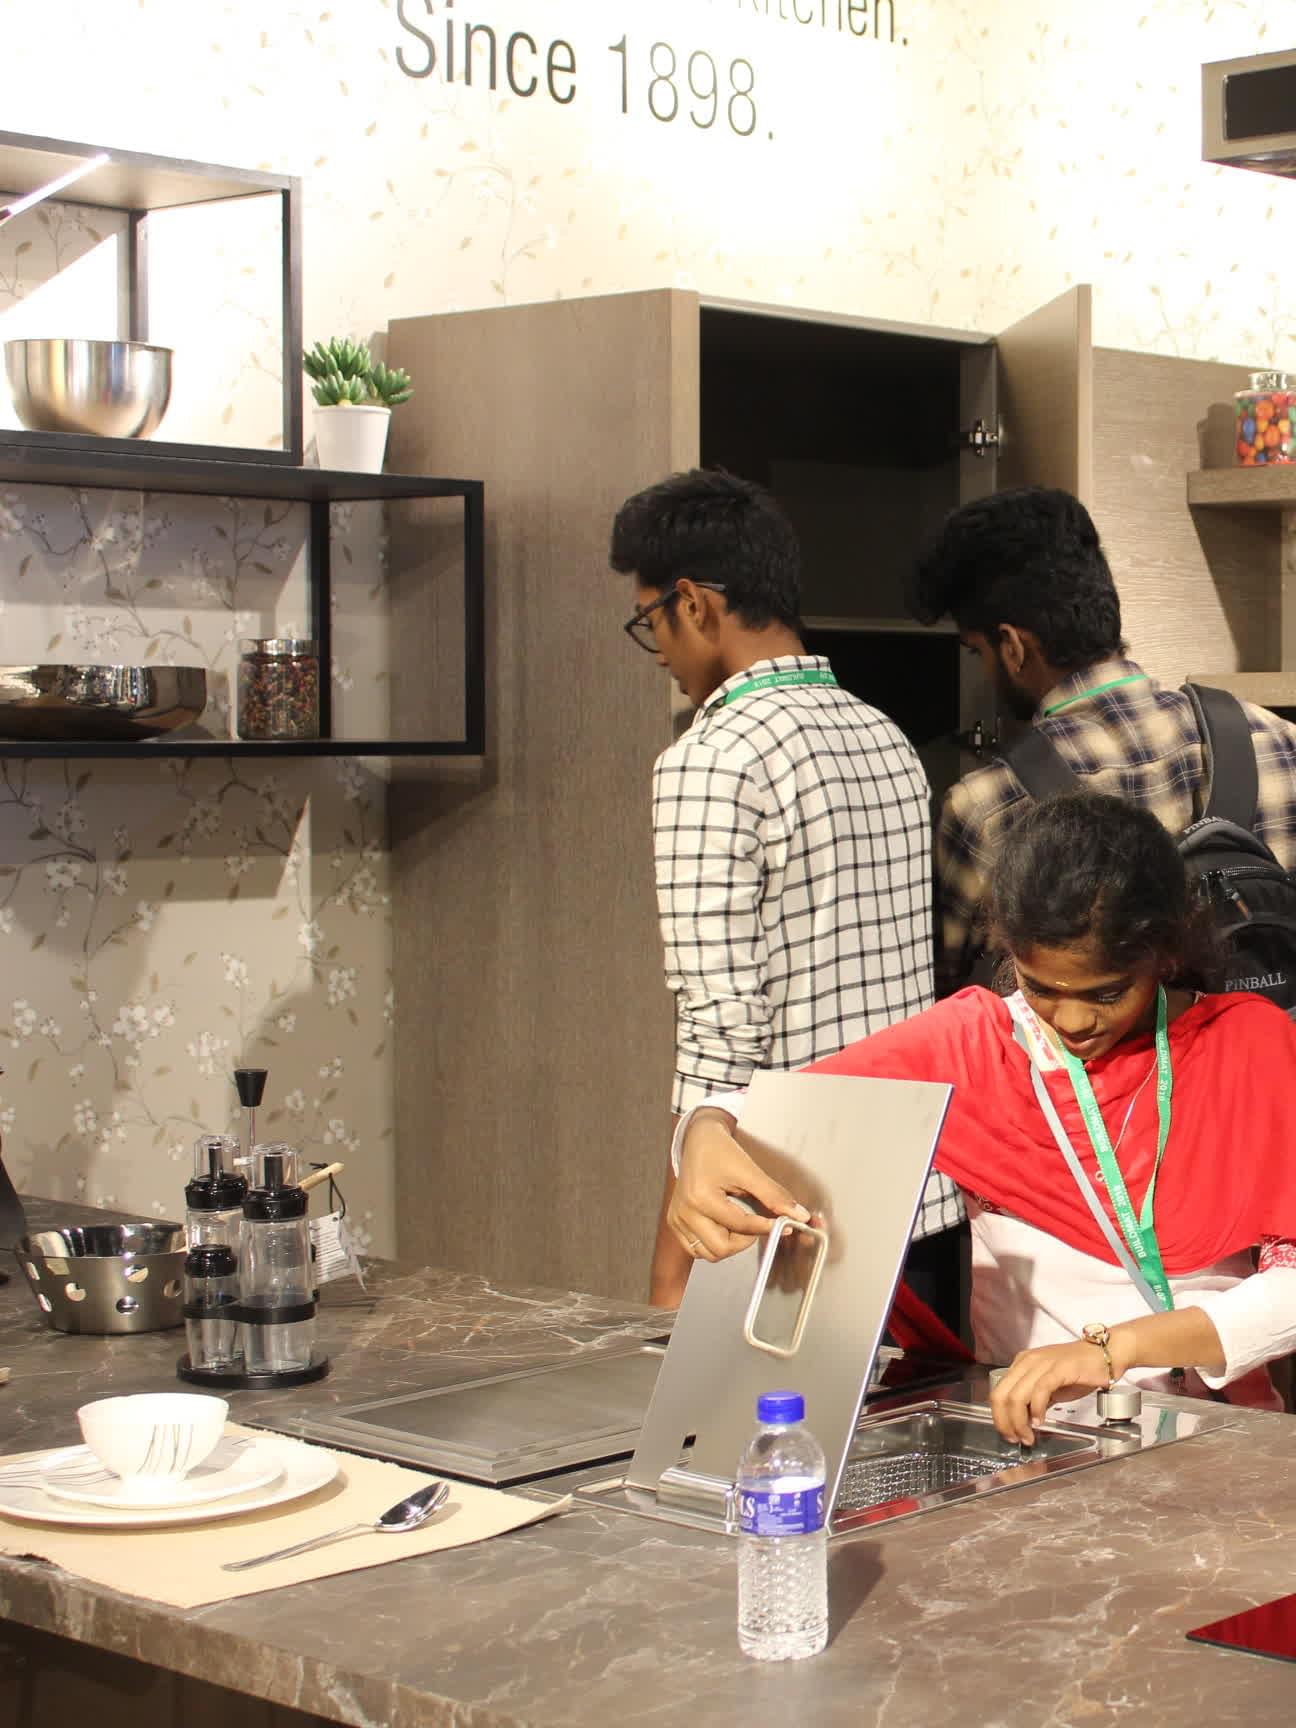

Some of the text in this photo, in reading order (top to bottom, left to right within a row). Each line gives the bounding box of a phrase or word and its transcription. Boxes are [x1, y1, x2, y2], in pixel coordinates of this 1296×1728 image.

[396, 0, 773, 140] Since 1898.
[1224, 972, 1287, 992] PINBALL
